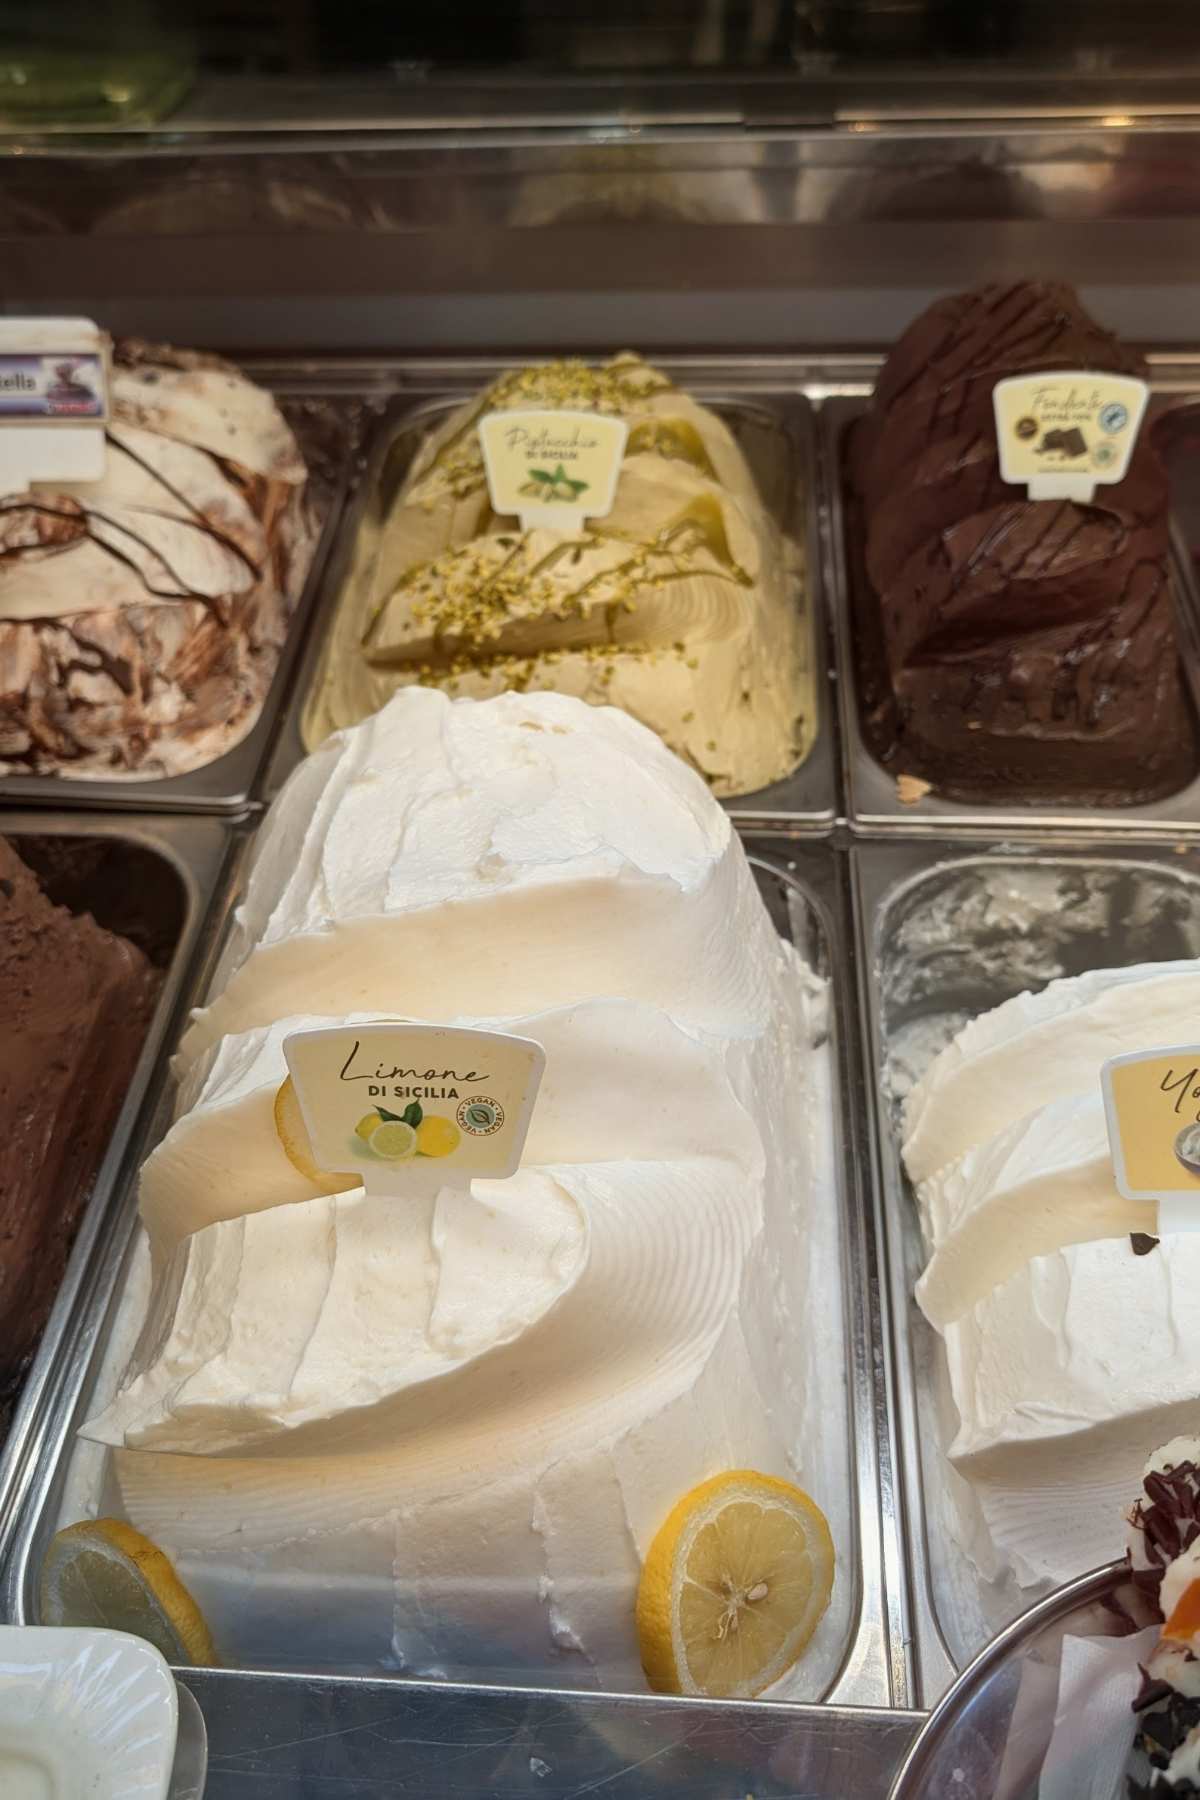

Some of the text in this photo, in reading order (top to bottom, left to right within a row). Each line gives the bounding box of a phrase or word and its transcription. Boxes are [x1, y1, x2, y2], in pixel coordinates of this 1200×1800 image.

[340, 1040, 490, 1083] Limone
[368, 1084, 460, 1099] DI SICILIA
[465, 1097, 496, 1108] VEGAN
